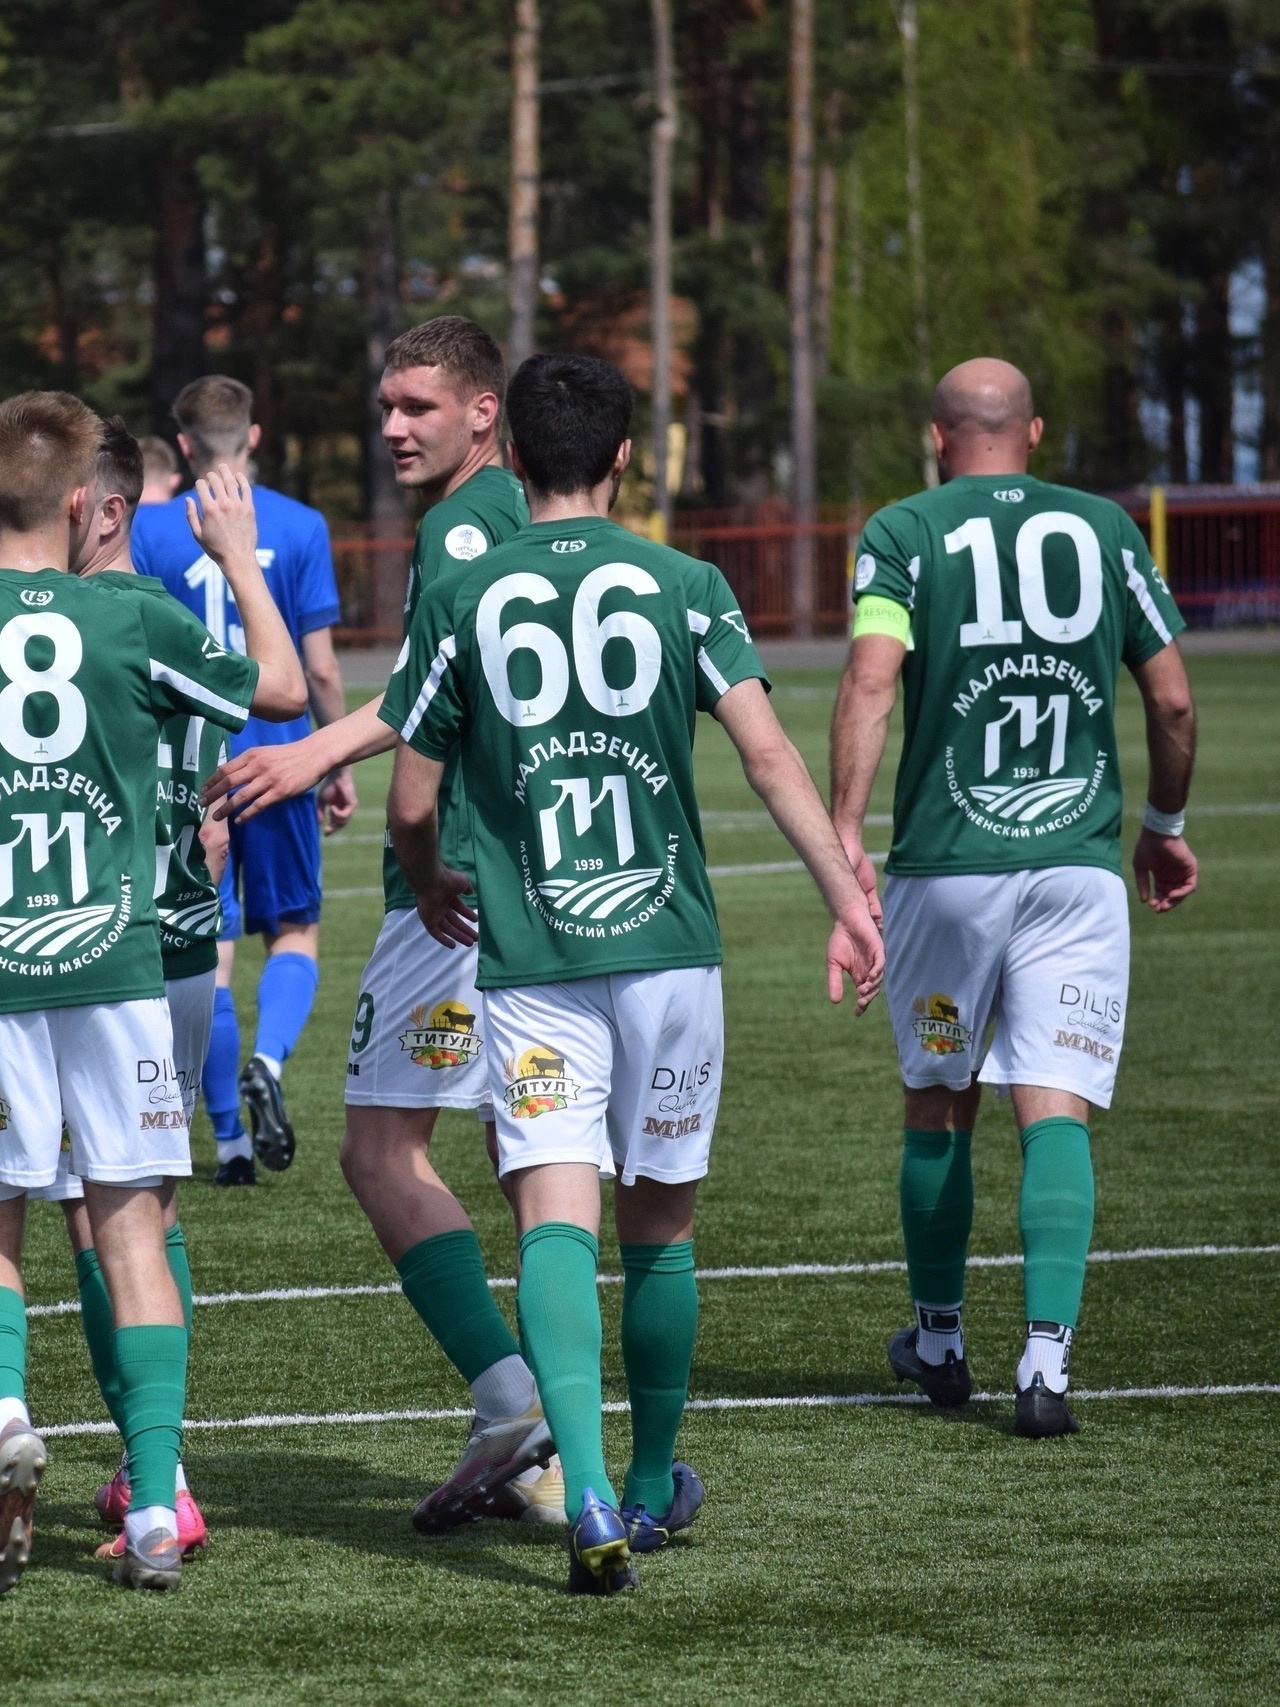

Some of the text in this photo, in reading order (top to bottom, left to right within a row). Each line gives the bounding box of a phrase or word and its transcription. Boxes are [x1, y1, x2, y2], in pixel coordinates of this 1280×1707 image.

[943, 511, 1103, 648] 10
[476, 562, 662, 727] 66
[952, 653, 1105, 717] МАЛАДЗЕЧНА
[515, 731, 669, 805] МАЛАДЗЕЧНА
[1013, 766, 1040, 779] 1939
[945, 745, 1109, 838] МОЛОДЕЧНЕНСКИЙ МЯСОКОМБИНАТ
[573, 858, 604, 872] 1939
[26, 893, 59, 908] 1939
[176, 890, 204, 902] 1939
[519, 832, 680, 938] МОЛОДЕЧНЕНСКИЙ МЯСОКОМБИНАТ
[60, 873, 131, 975] МЯСОКОМБИНАТ
[1060, 983, 1122, 1023] DILIS
[351, 992, 375, 1053] 9
[921, 1021, 961, 1039] ТИТУЛ
[412, 1033, 472, 1050] ТИТУЛ
[1054, 1029, 1115, 1065] MMZ
[509, 1080, 567, 1099] ТИТУЛ
[651, 1061, 711, 1093] DILIS
[642, 1113, 702, 1140] MMZ
